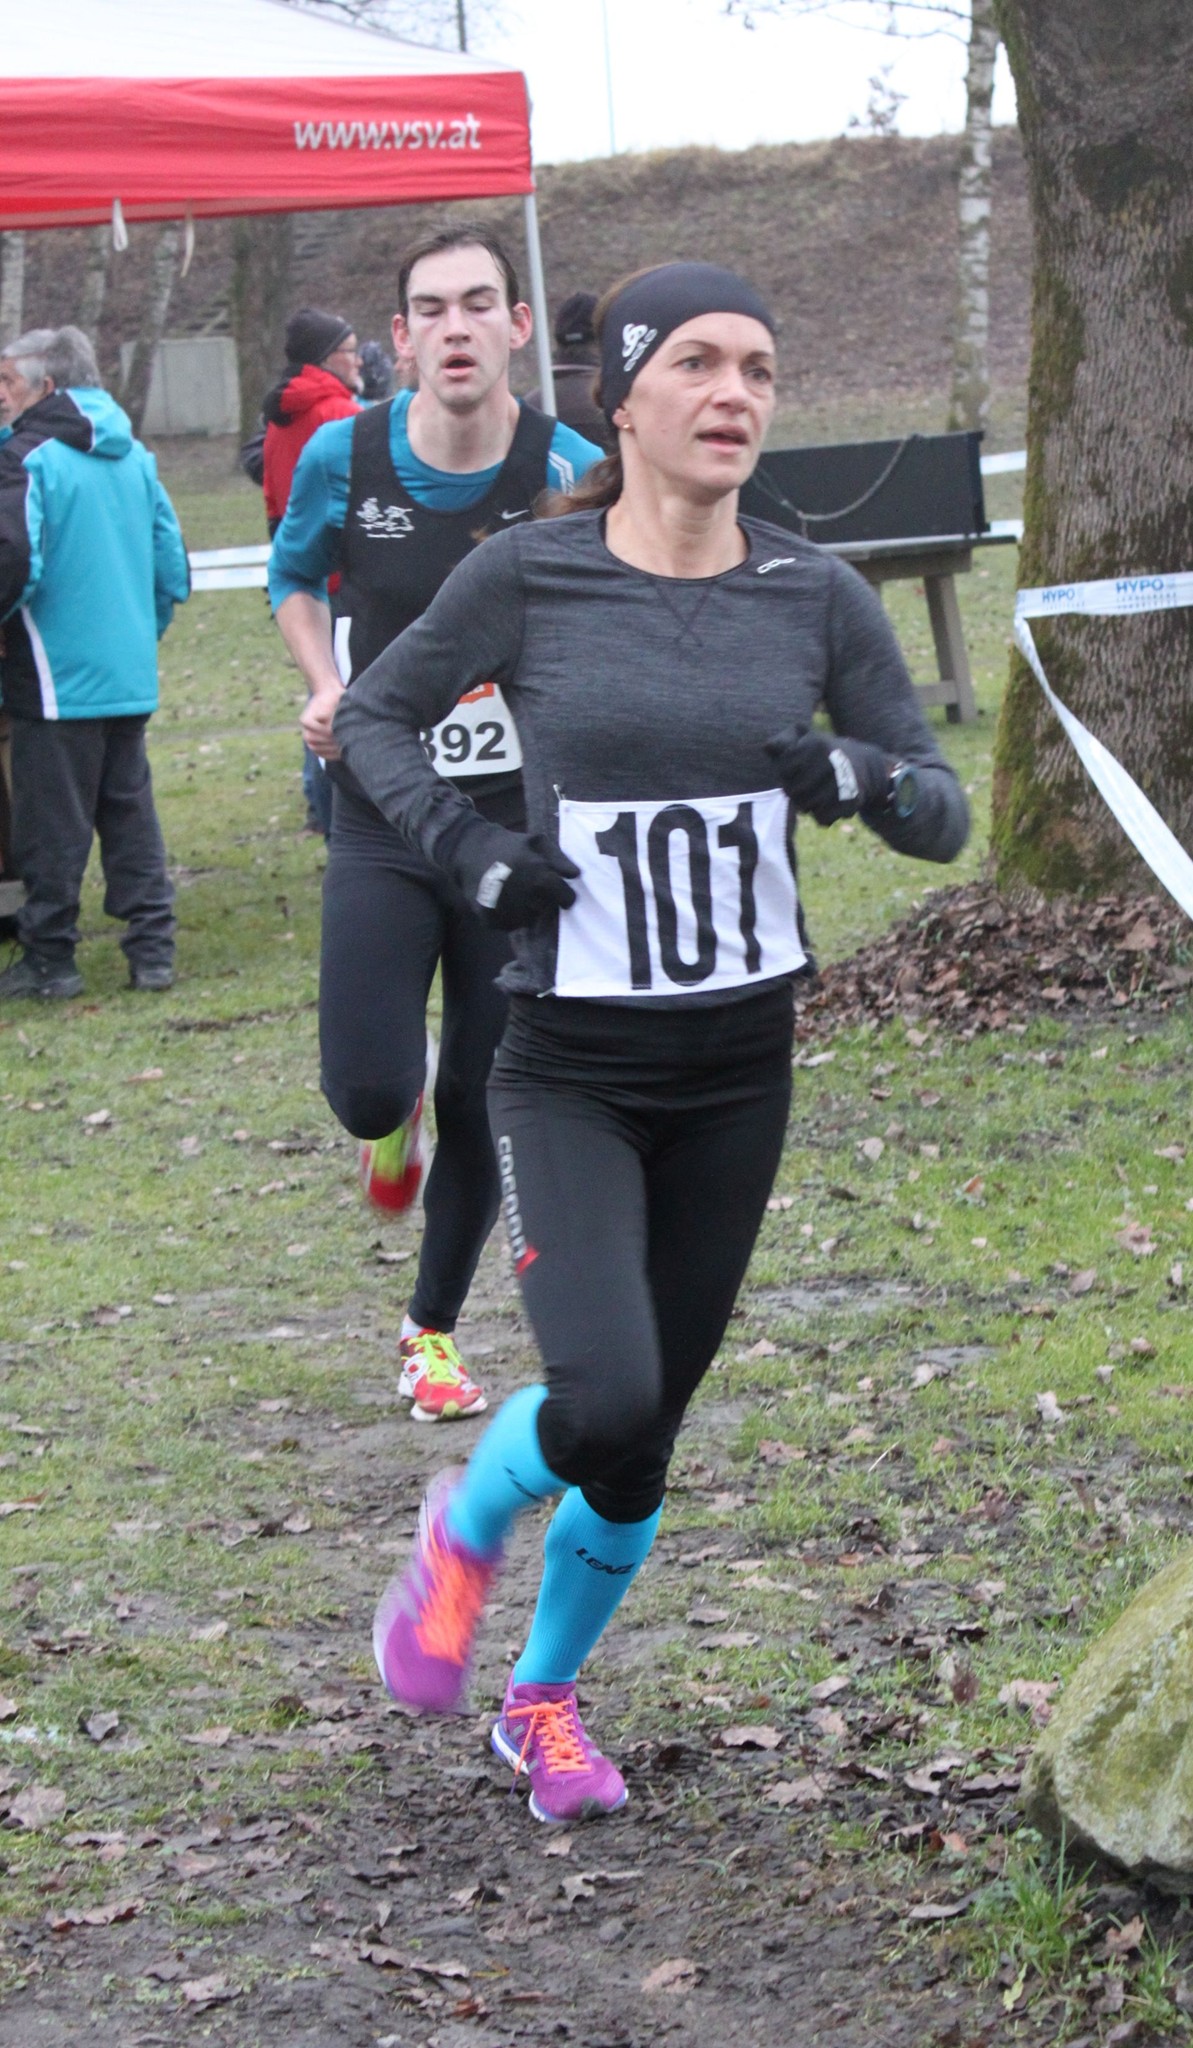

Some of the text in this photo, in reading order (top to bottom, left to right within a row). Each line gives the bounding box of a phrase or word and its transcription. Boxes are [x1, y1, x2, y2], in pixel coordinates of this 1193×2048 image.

[294, 113, 481, 150] www.vsv.at
[1042, 588, 1076, 603] HYPO
[1115, 578, 1165, 593] HYPO
[594, 802, 762, 991] 101
